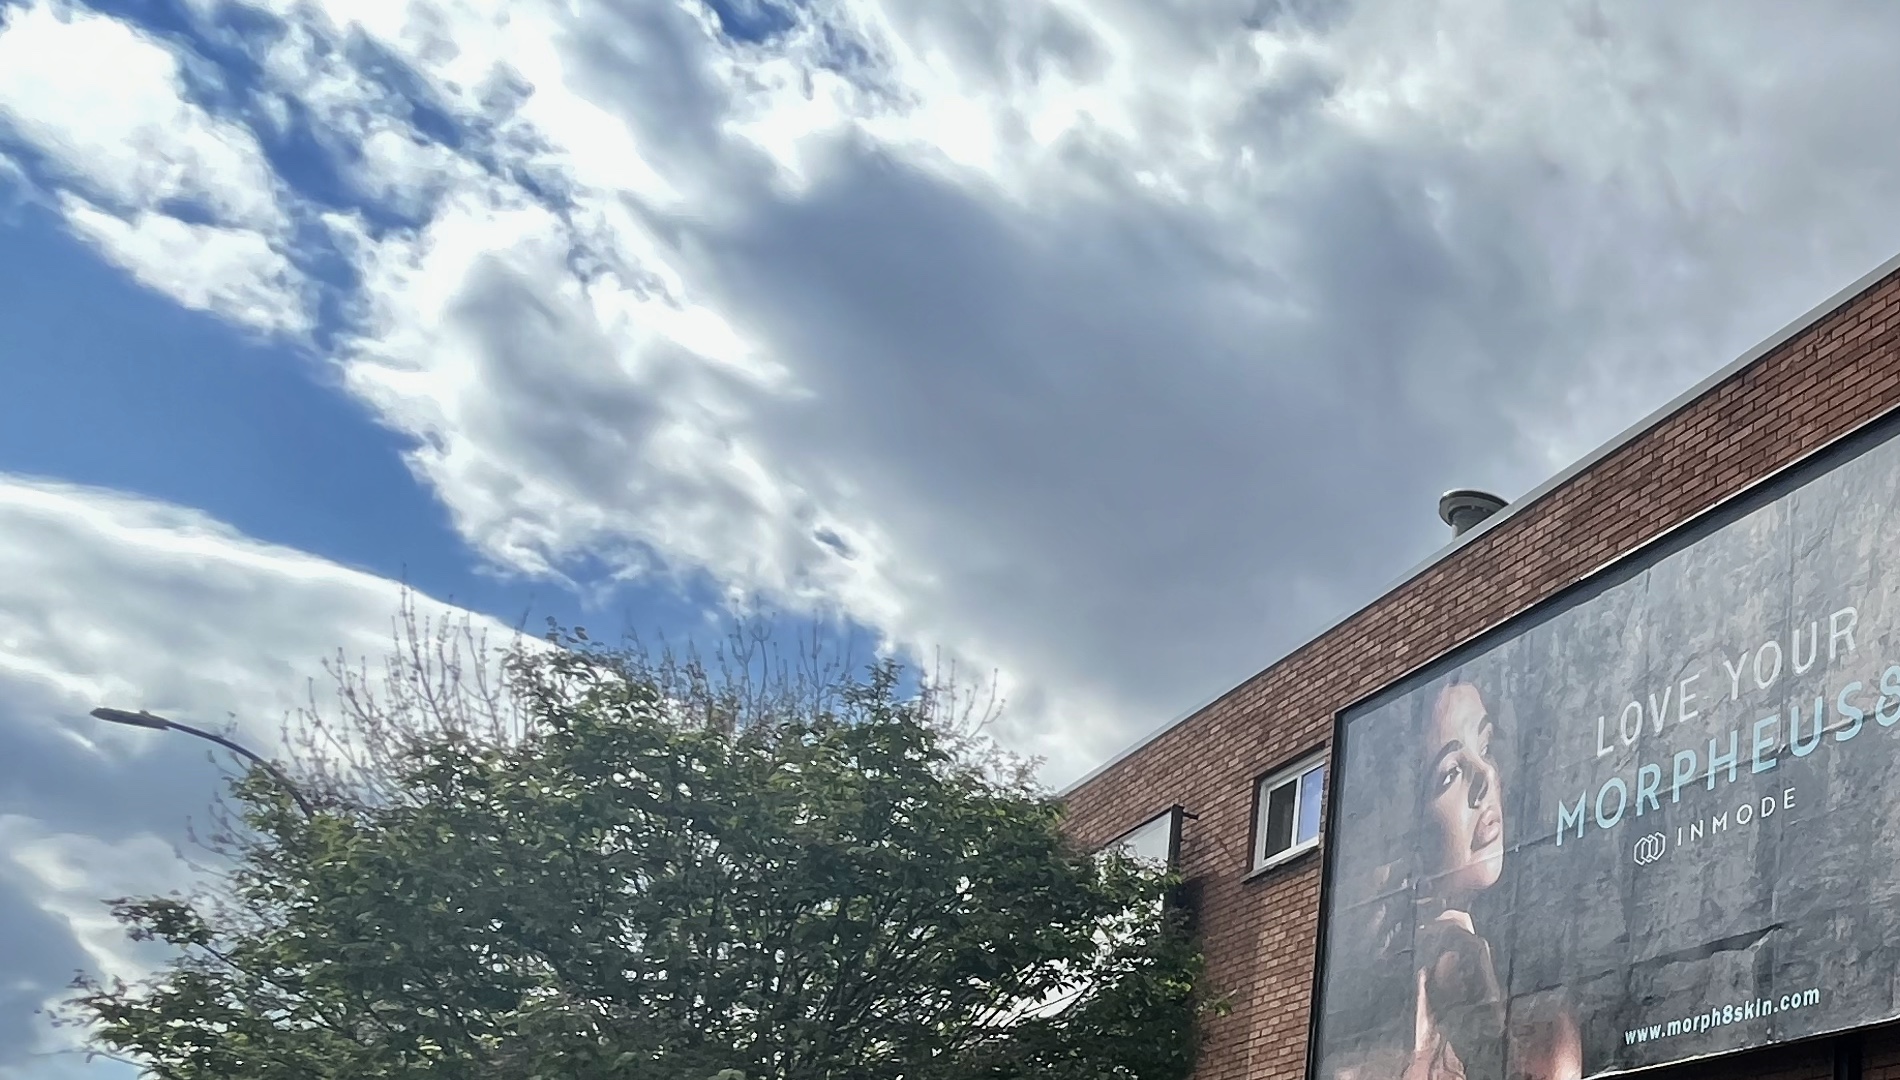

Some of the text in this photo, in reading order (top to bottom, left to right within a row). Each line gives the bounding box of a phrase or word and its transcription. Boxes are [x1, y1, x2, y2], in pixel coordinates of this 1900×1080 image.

[1595, 605, 1860, 758] LOVE YOUR
[1676, 786, 1797, 847] INMODE
[1623, 986, 1821, 1045] www.morph8skin.com
